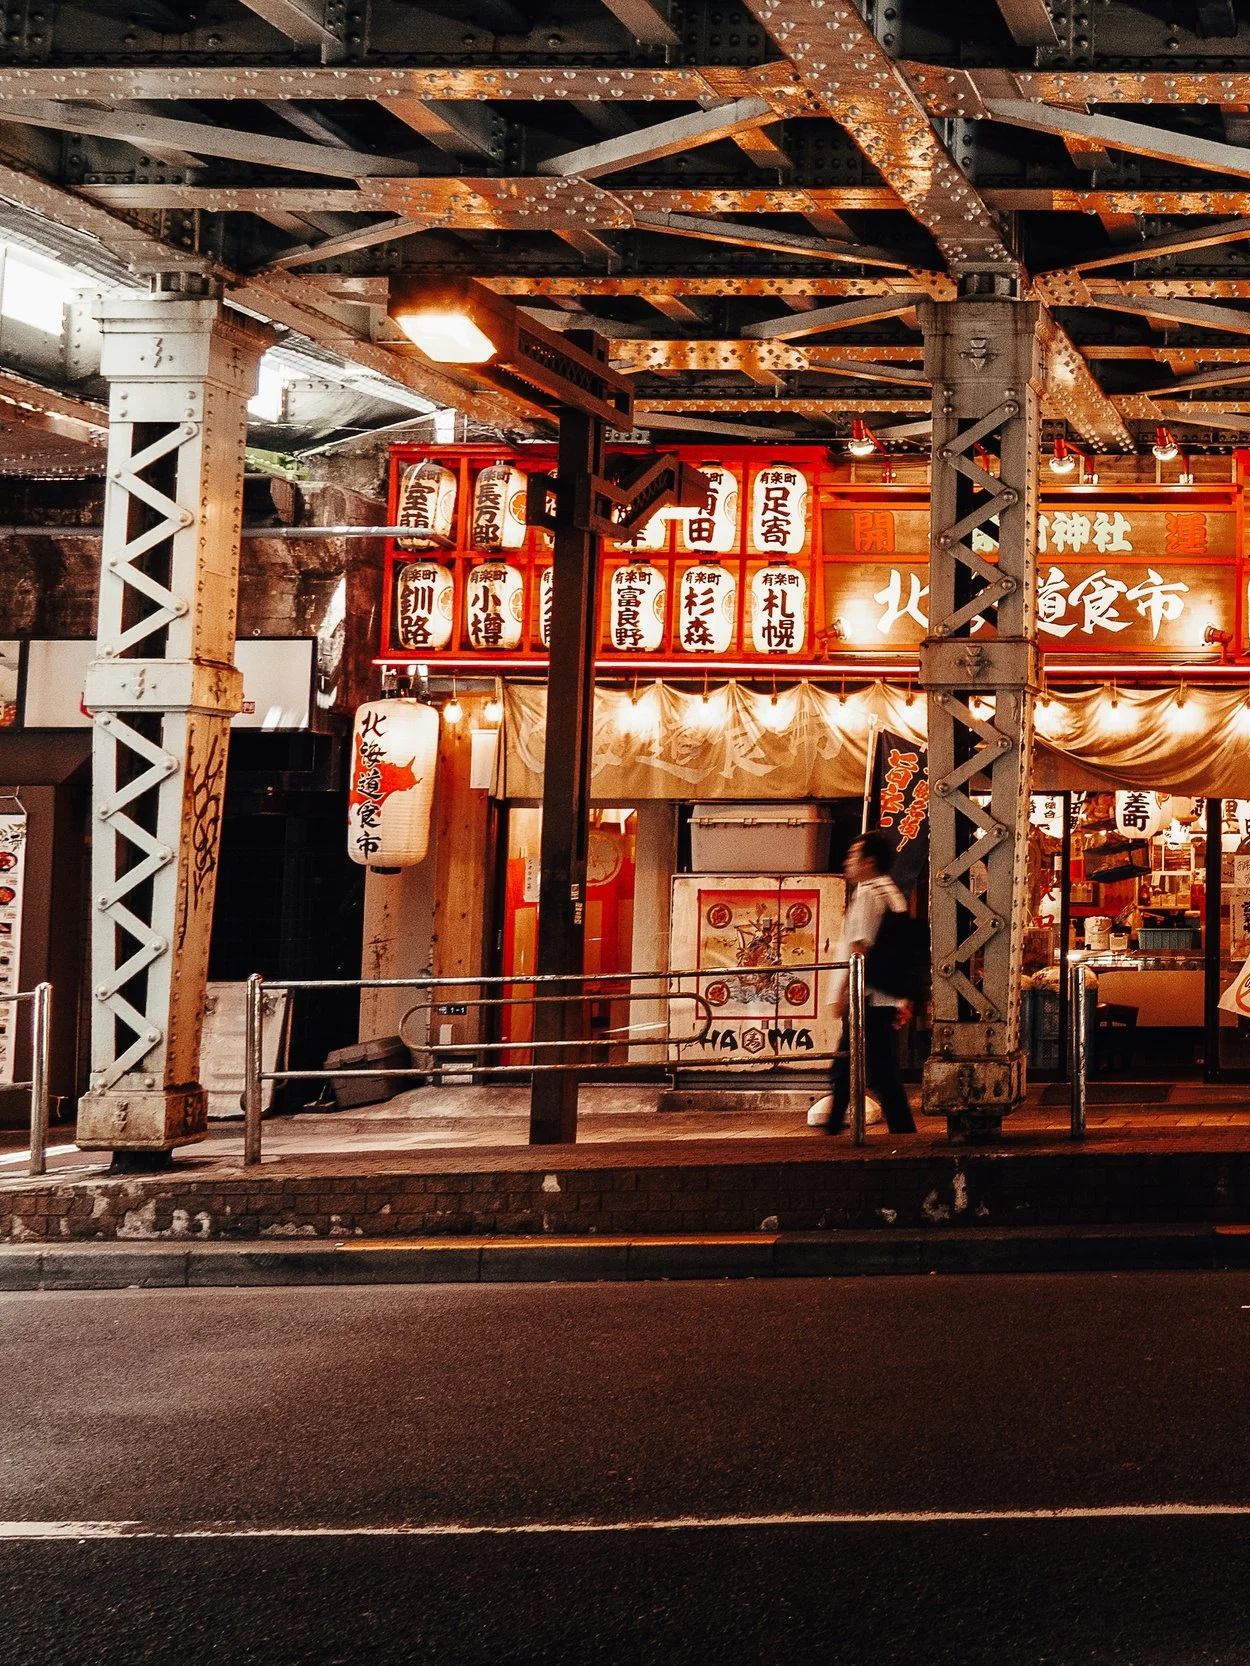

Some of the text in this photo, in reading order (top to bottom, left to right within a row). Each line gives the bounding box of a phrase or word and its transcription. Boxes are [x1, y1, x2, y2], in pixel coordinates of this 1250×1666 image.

[760, 471, 797, 486] 有楽町
[473, 483, 502, 544] 長万部
[761, 487, 791, 546] 足寄
[615, 571, 652, 586] 有楽町
[686, 571, 722, 586] 有楽町
[762, 573, 799, 587] 有楽町
[400, 585, 434, 645] 釧路
[471, 585, 505, 645] 小樽
[615, 585, 645, 646] 富良野
[762, 588, 794, 648] 札幌
[356, 711, 387, 860] 北海道食市
